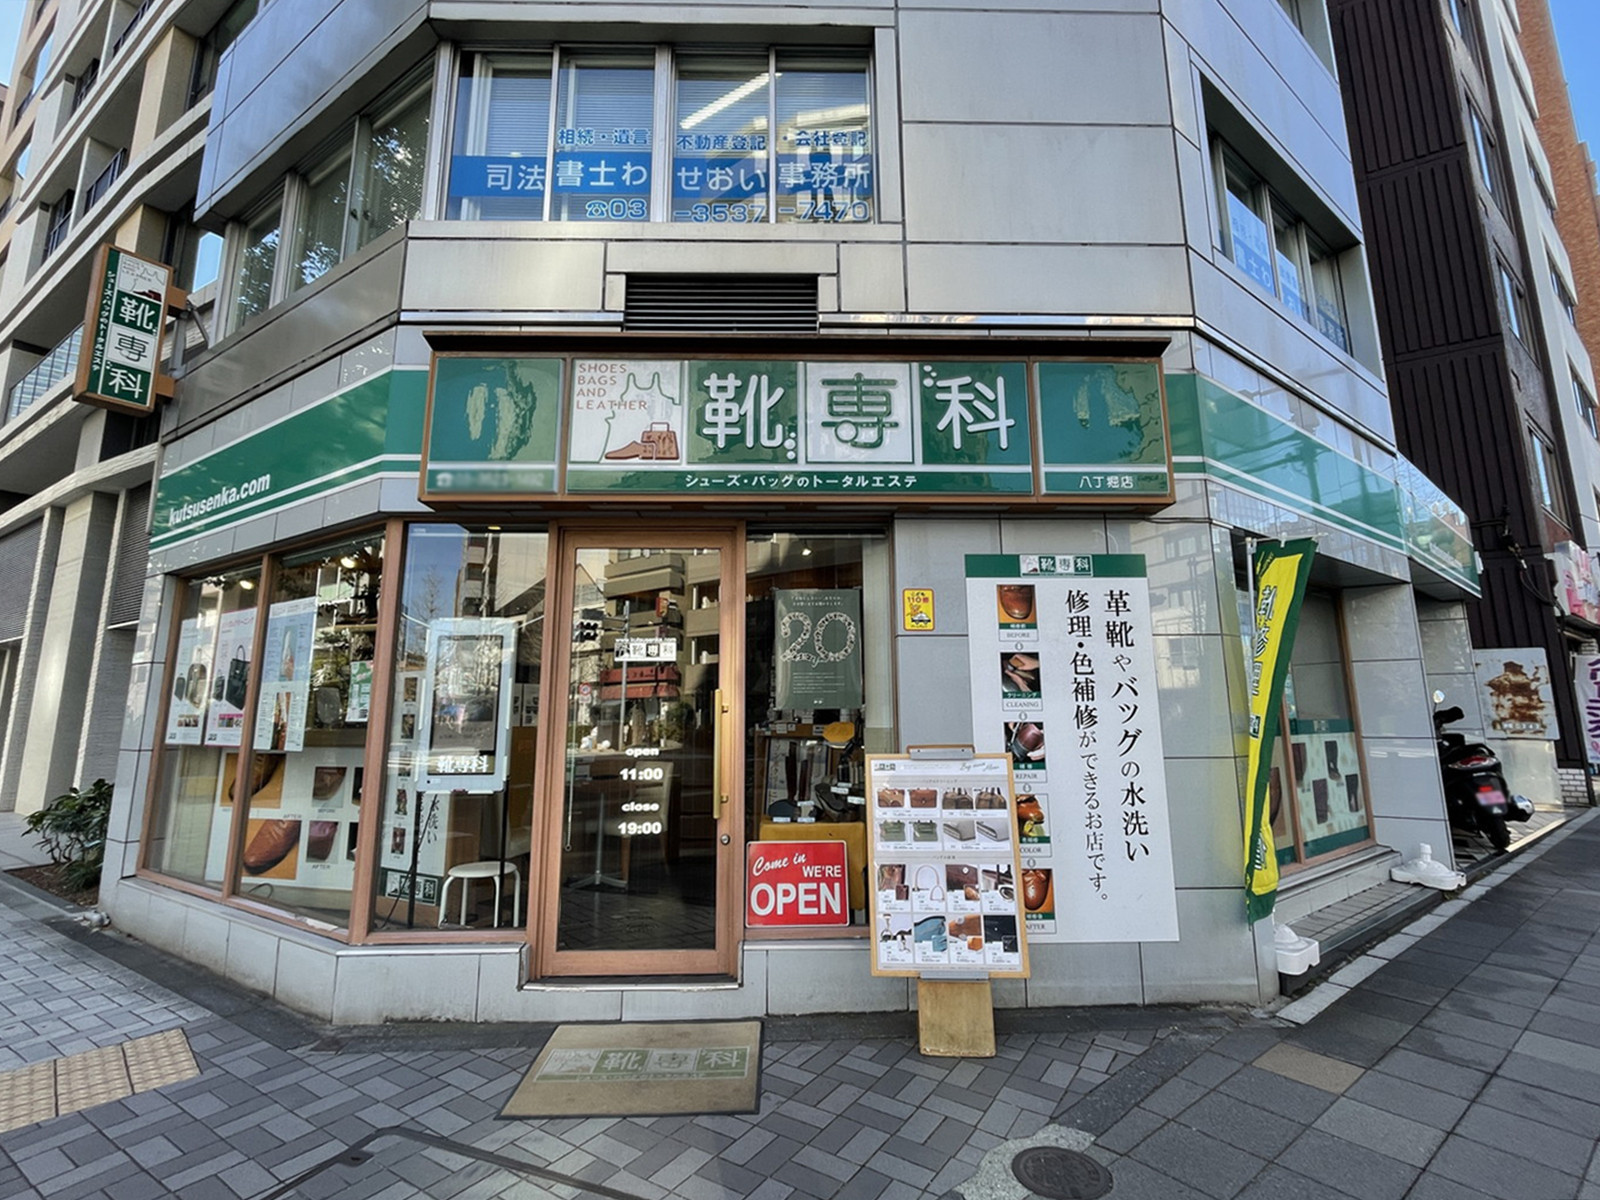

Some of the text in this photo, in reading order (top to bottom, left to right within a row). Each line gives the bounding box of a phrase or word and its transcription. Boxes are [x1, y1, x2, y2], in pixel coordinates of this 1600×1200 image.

[107, 296, 156, 399] 靴専科
[578, 362, 627, 374] SHOES
[577, 375, 617, 386] BAGS
[576, 387, 607, 398] AND
[575, 400, 648, 411] LEATHER
[703, 372, 1015, 450] 靴専科
[685, 474, 918, 489] シューズ・バッグのトータルエステ
[1079, 475, 1135, 489] 八丁堀店
[168, 473, 271, 527] kutsusenka.com
[1040, 556, 1090, 572] 靴専科
[1065, 589, 1108, 900] 修理・色補修ができるお店です。
[625, 748, 660, 758] open
[619, 767, 664, 781] 11:00
[621, 801, 660, 812] close
[618, 821, 663, 835] 19:00
[752, 852, 807, 877] Come in
[802, 865, 842, 878] WE'RE
[750, 882, 842, 916] OPEN
